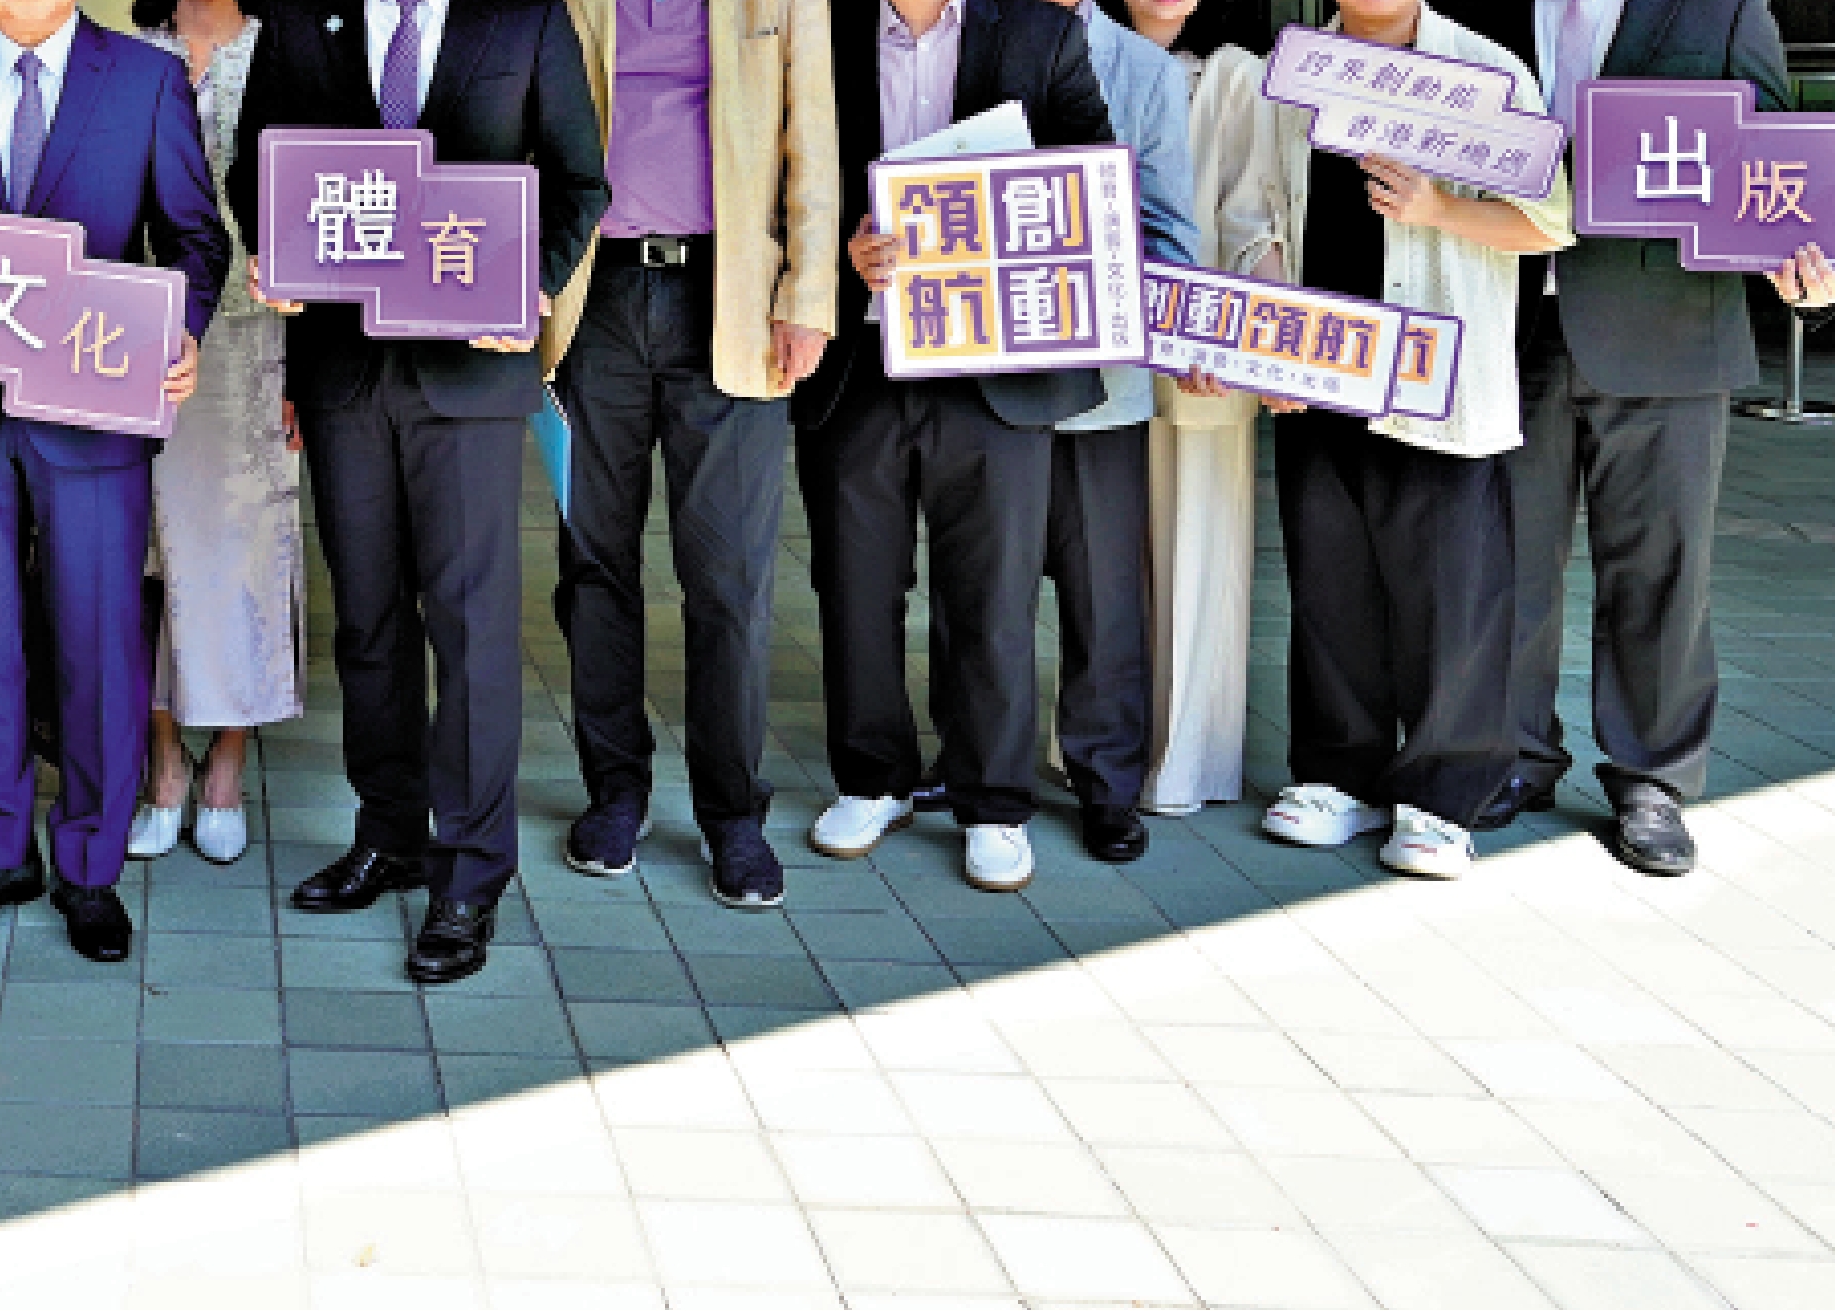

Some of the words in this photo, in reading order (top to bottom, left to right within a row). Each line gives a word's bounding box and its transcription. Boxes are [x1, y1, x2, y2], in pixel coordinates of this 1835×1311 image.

[309, 168, 487, 285] 體育
[1634, 115, 1816, 223] 出版
[896, 178, 991, 348] 領航
[998, 172, 1089, 344] 創動
